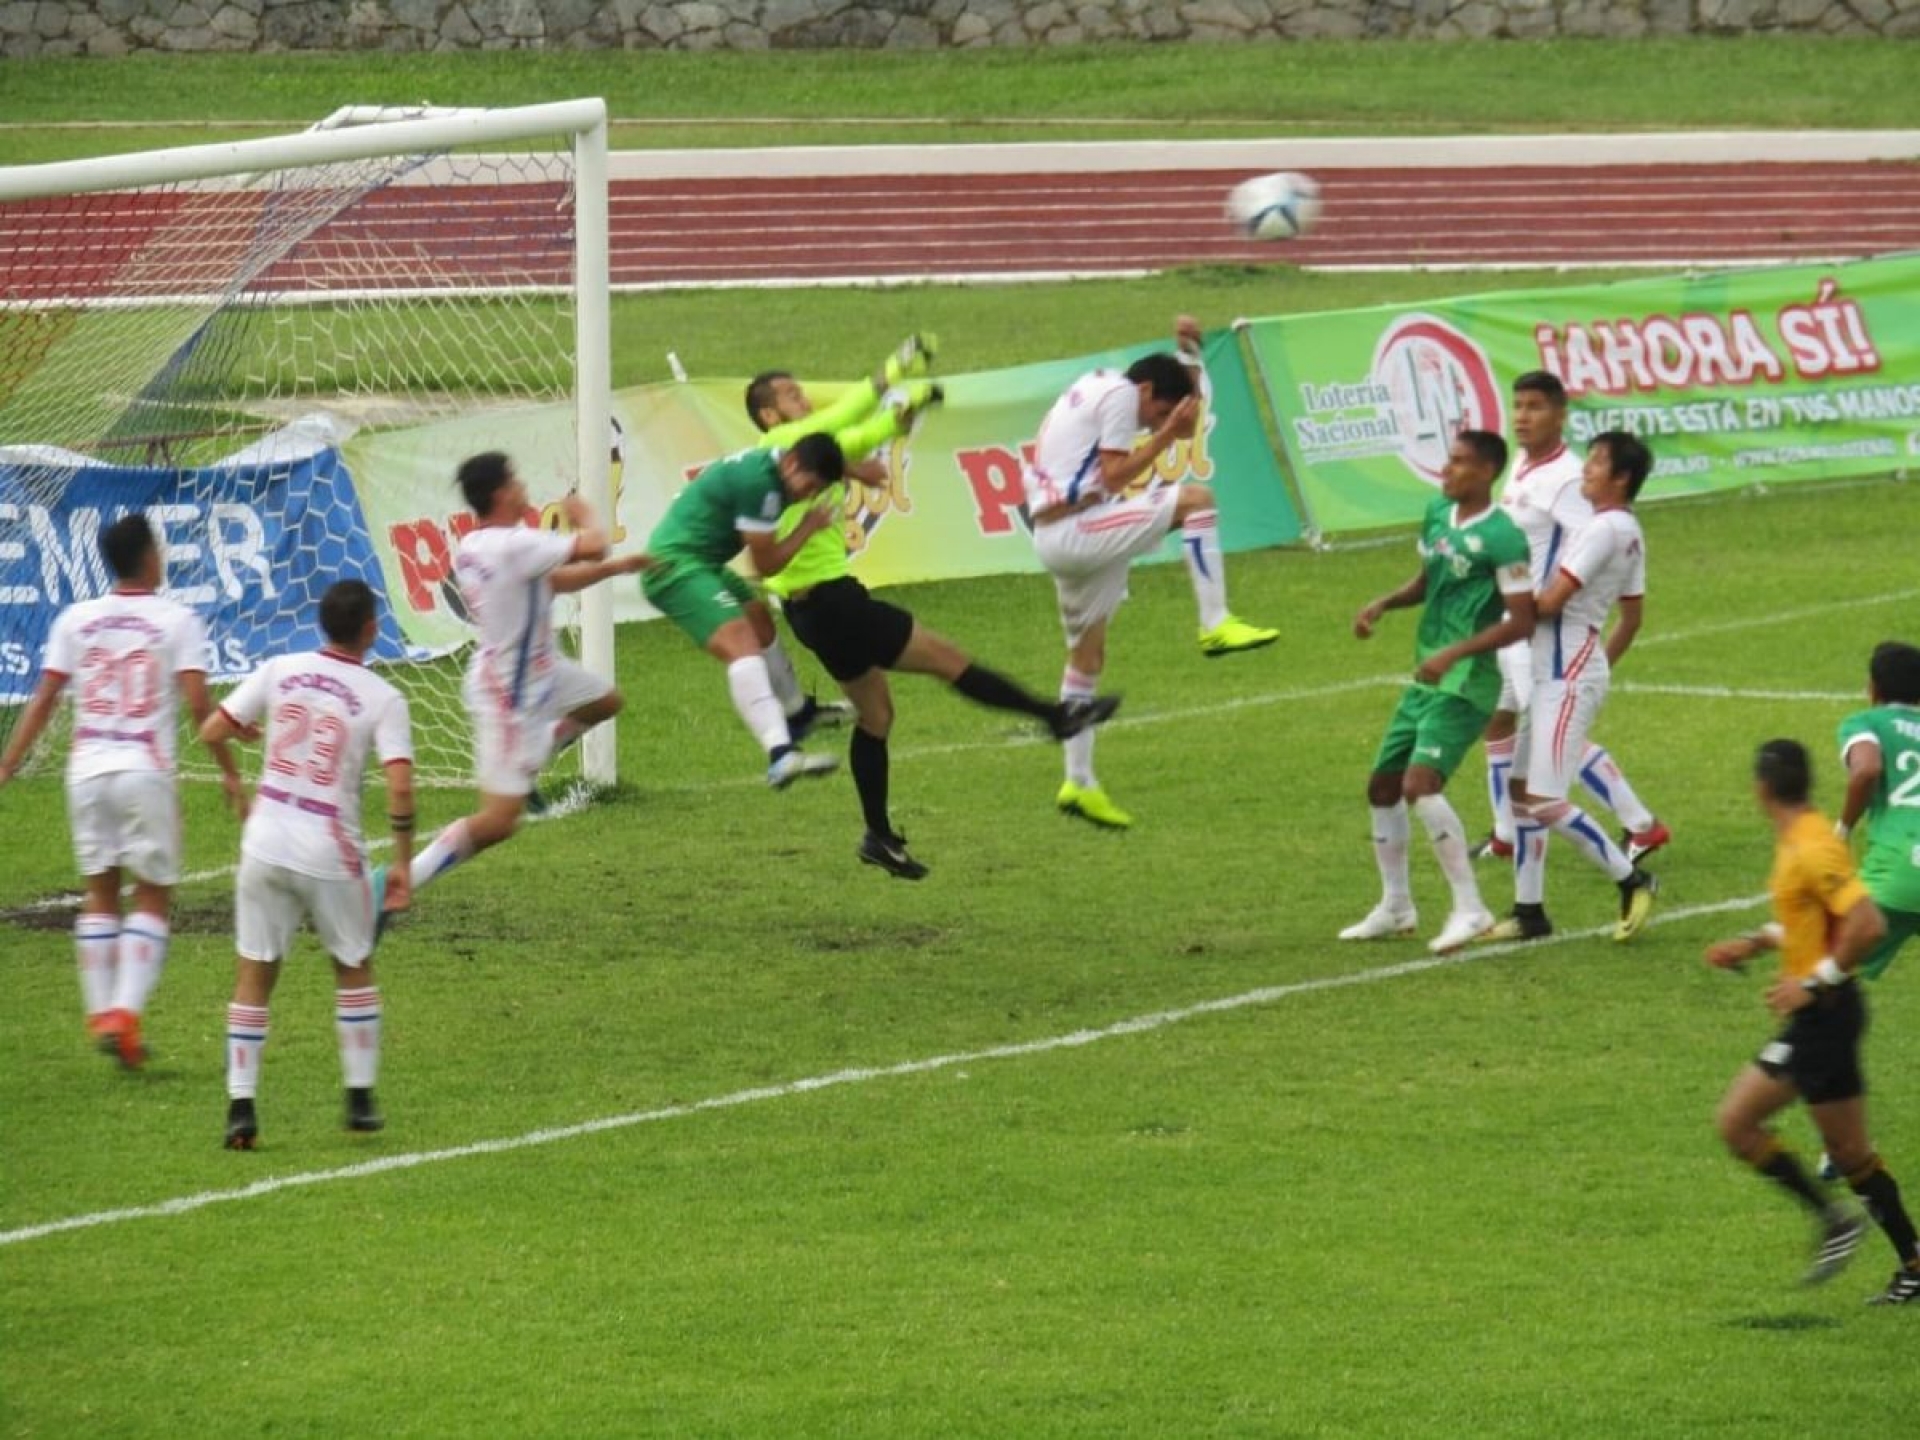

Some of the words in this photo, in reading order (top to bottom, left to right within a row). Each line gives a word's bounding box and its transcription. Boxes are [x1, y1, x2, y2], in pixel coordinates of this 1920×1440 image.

[1779, 278, 1880, 378] SÍ!
[1296, 409, 1399, 446] Nacional
[1568, 406, 1677, 441] SUERTE
[1747, 397, 1781, 427] EN
[1782, 393, 1838, 422] TUS
[83, 647, 157, 717] 20
[270, 703, 347, 786] 23
